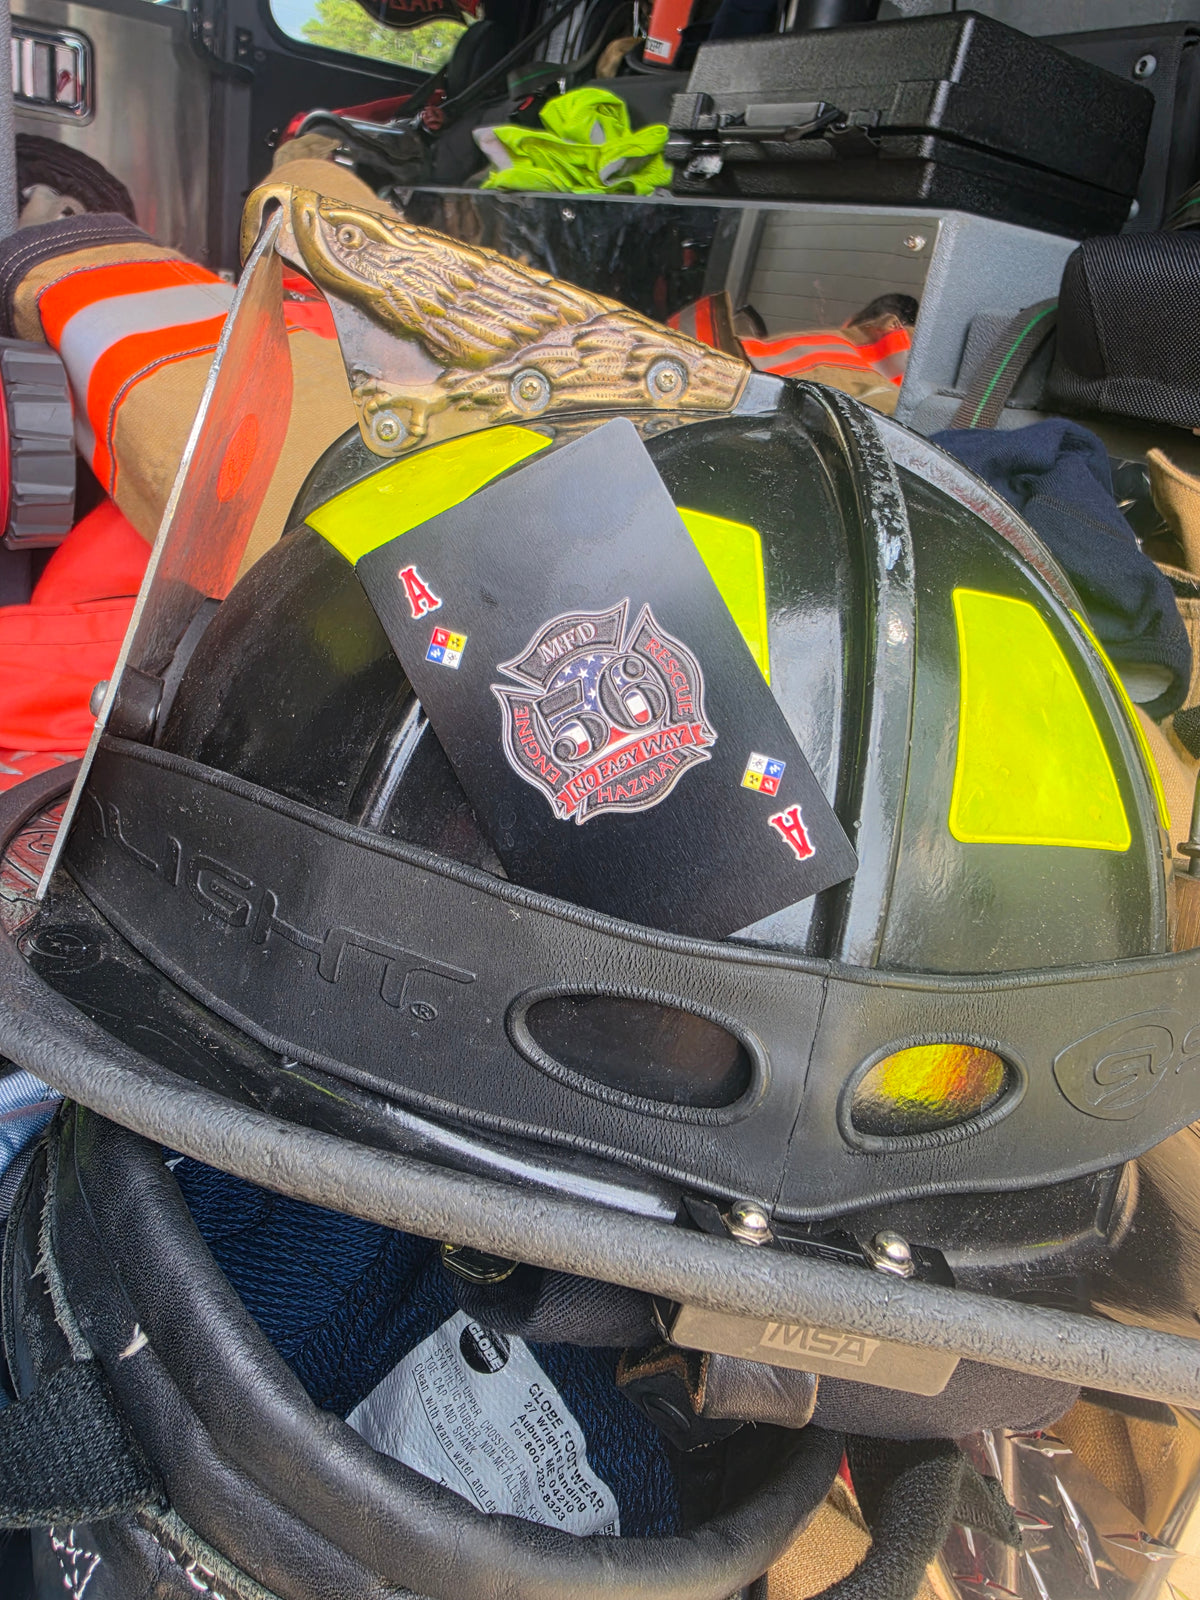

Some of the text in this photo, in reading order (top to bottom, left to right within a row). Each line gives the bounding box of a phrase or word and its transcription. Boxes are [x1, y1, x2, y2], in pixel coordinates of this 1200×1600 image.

[399, 565, 443, 619] A
[538, 621, 598, 666] MFD
[643, 636, 694, 717] RESCUE
[513, 704, 563, 785] ENGINE
[532, 653, 667, 767] 56
[571, 728, 686, 799] NO EASY WAY
[597, 752, 682, 803] HAZMAT
[768, 804, 816, 861] A
[468, 1321, 505, 1374] GLOBE
[767, 1322, 868, 1362] MSA
[414, 1362, 430, 1393] Clean
[425, 1395, 440, 1420] with
[435, 1422, 455, 1451] warm
[452, 1450, 475, 1477] water
[472, 1478, 489, 1499] and
[425, 1355, 439, 1377] TOE
[443, 1403, 458, 1425] AND
[452, 1425, 479, 1456] SHANK
[434, 1348, 462, 1402] SYNTHETIC
[456, 1402, 482, 1442] RUBBER,
[479, 1440, 522, 1503] NON-METALLIC
[442, 1342, 467, 1386] LEATHER
[480, 1419, 519, 1464] CROSSTECH
[529, 1382, 605, 1513] GLOBE FOOTWEAR
[509, 1420, 566, 1522] Tel: 800-232-8323
[517, 1413, 576, 1514] Auburn, ME 04210
[523, 1401, 588, 1513] 27 Wrights Landing
